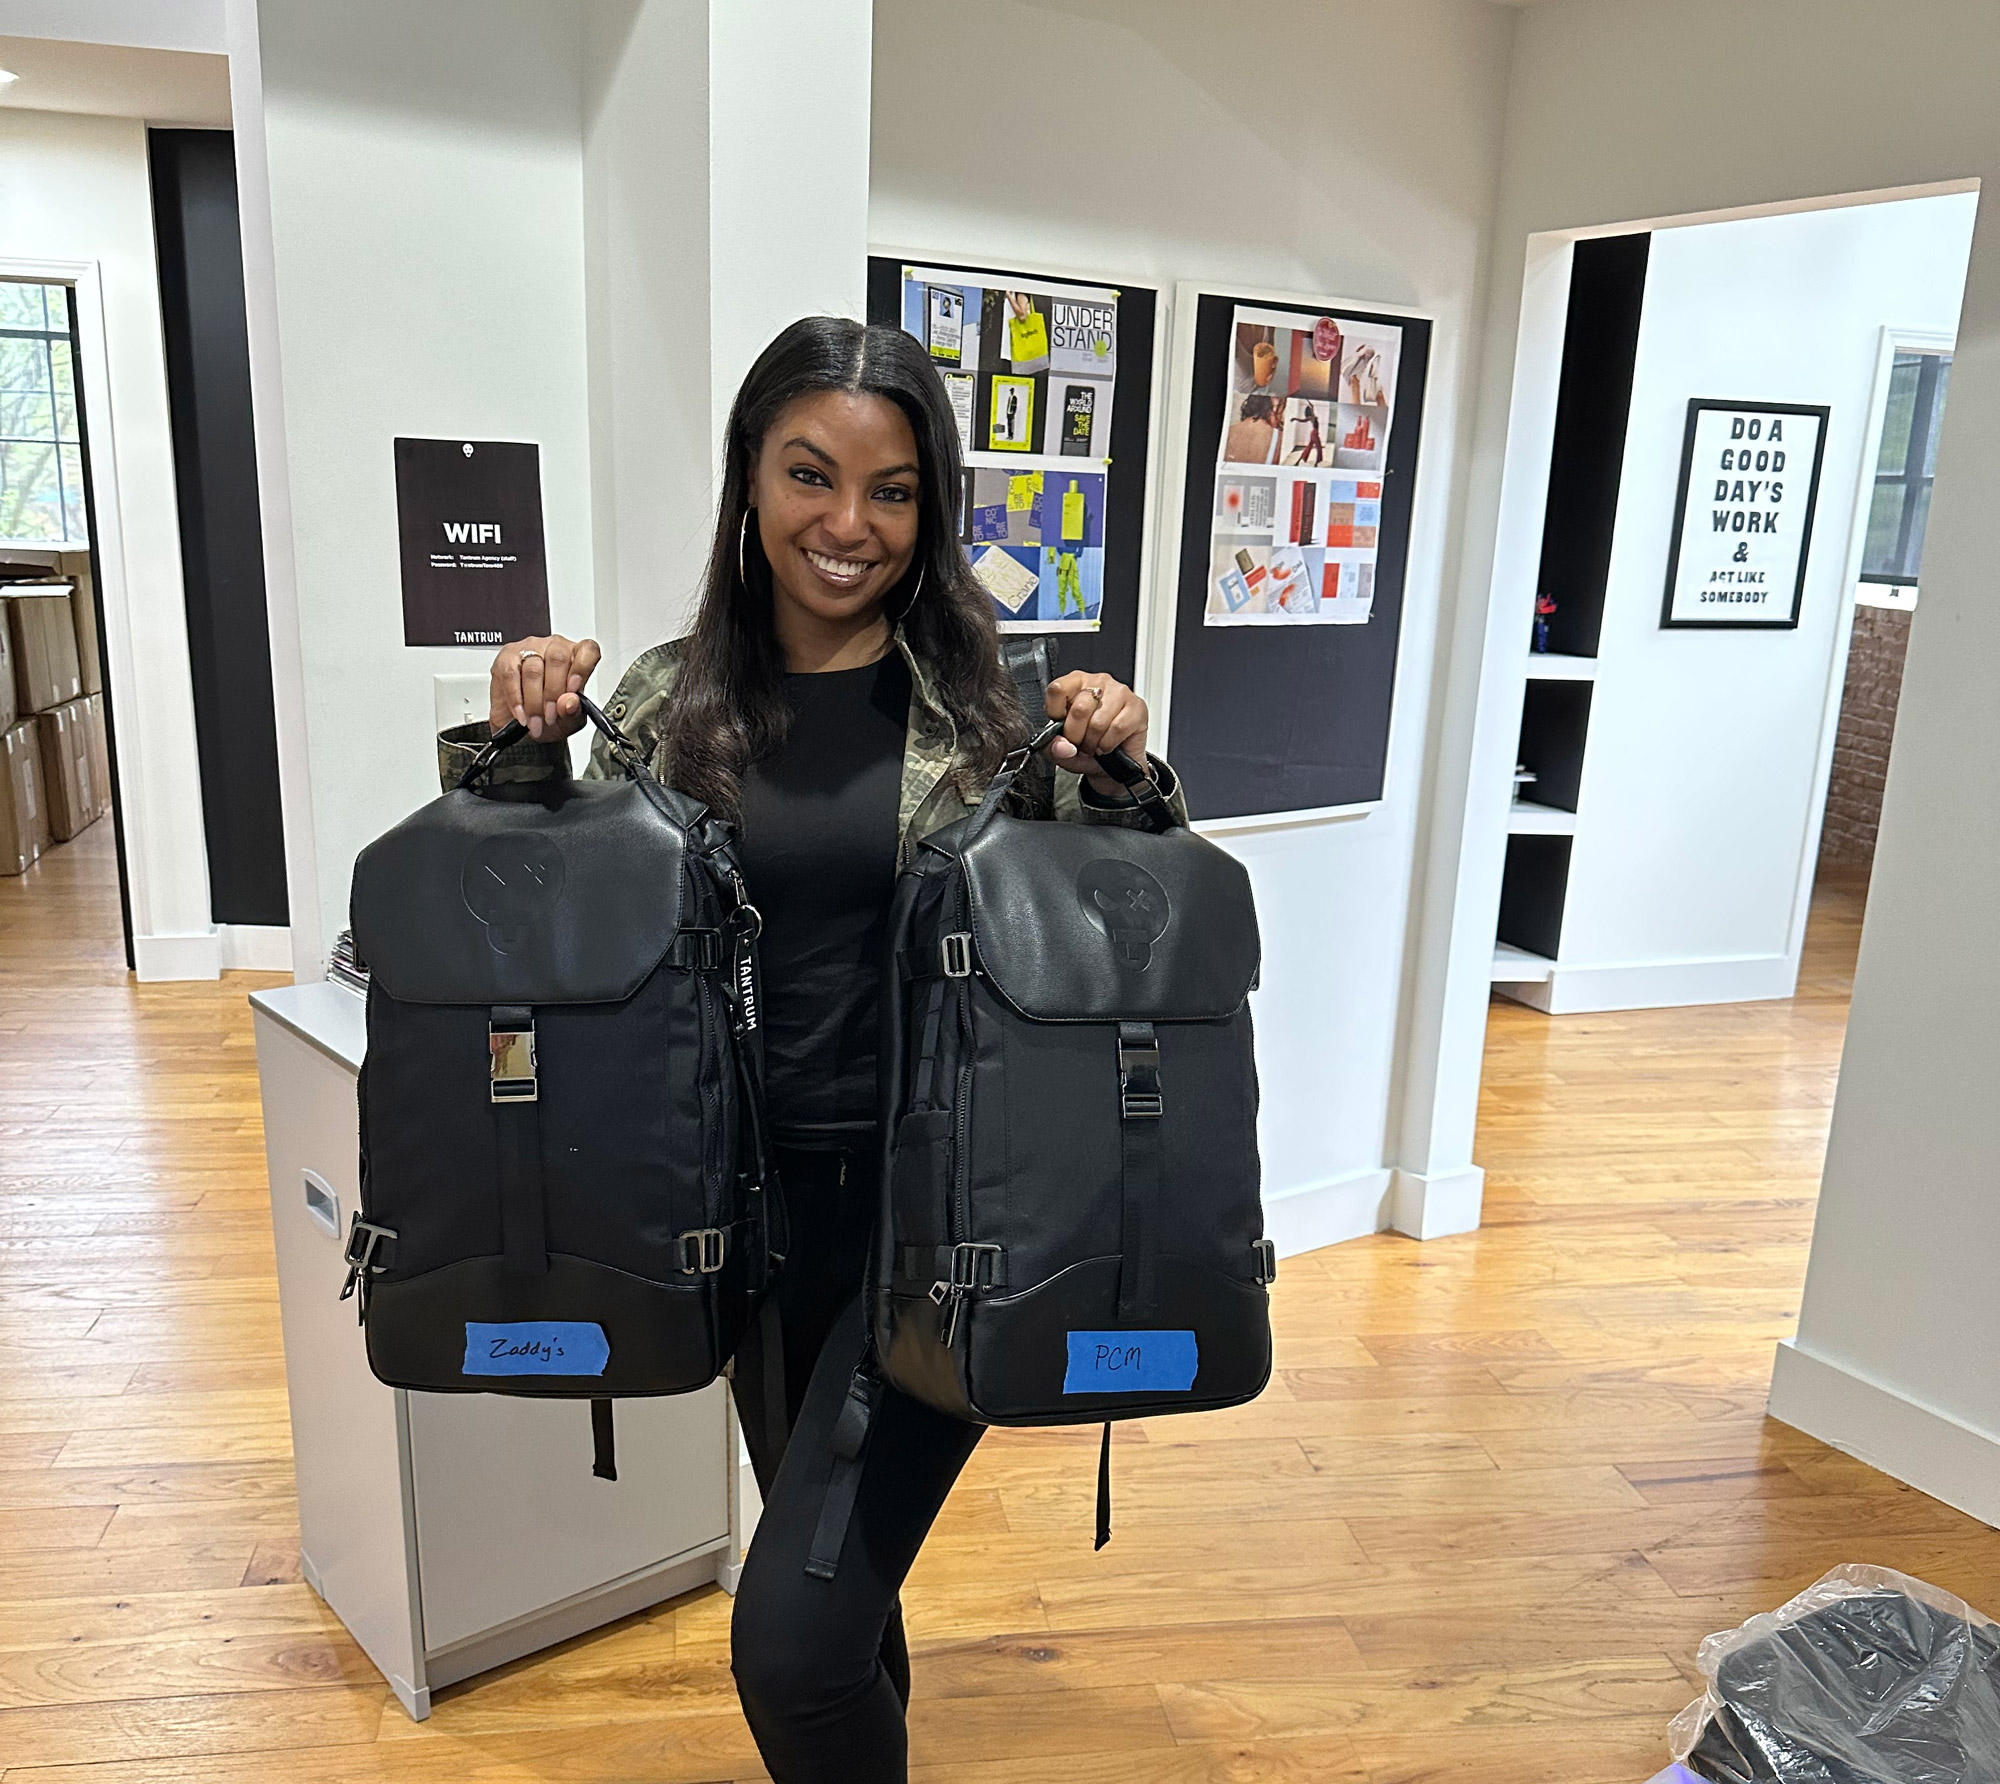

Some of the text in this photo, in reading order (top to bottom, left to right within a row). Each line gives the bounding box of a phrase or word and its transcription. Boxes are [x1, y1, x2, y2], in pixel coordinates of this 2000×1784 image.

[1054, 304, 1113, 331] UNDER
[1053, 326, 1112, 351] STAND
[1080, 391, 1093, 400] THE
[1073, 428, 1090, 436] DATE
[1731, 417, 1783, 442] DO A
[1720, 448, 1786, 472] GOOD
[1714, 479, 1784, 503] DAY'S
[443, 522, 502, 544] WIFI
[1712, 510, 1780, 533] WORK
[1733, 541, 1749, 563] &
[1709, 571, 1766, 584] ACT LIKE
[1700, 591, 1769, 604] SOMEBODY
[454, 631, 503, 643] TANTRUM
[740, 956, 757, 1031] TANTRUM
[489, 1336, 565, 1362] Zaddy's
[1095, 1344, 1141, 1371] PCM
